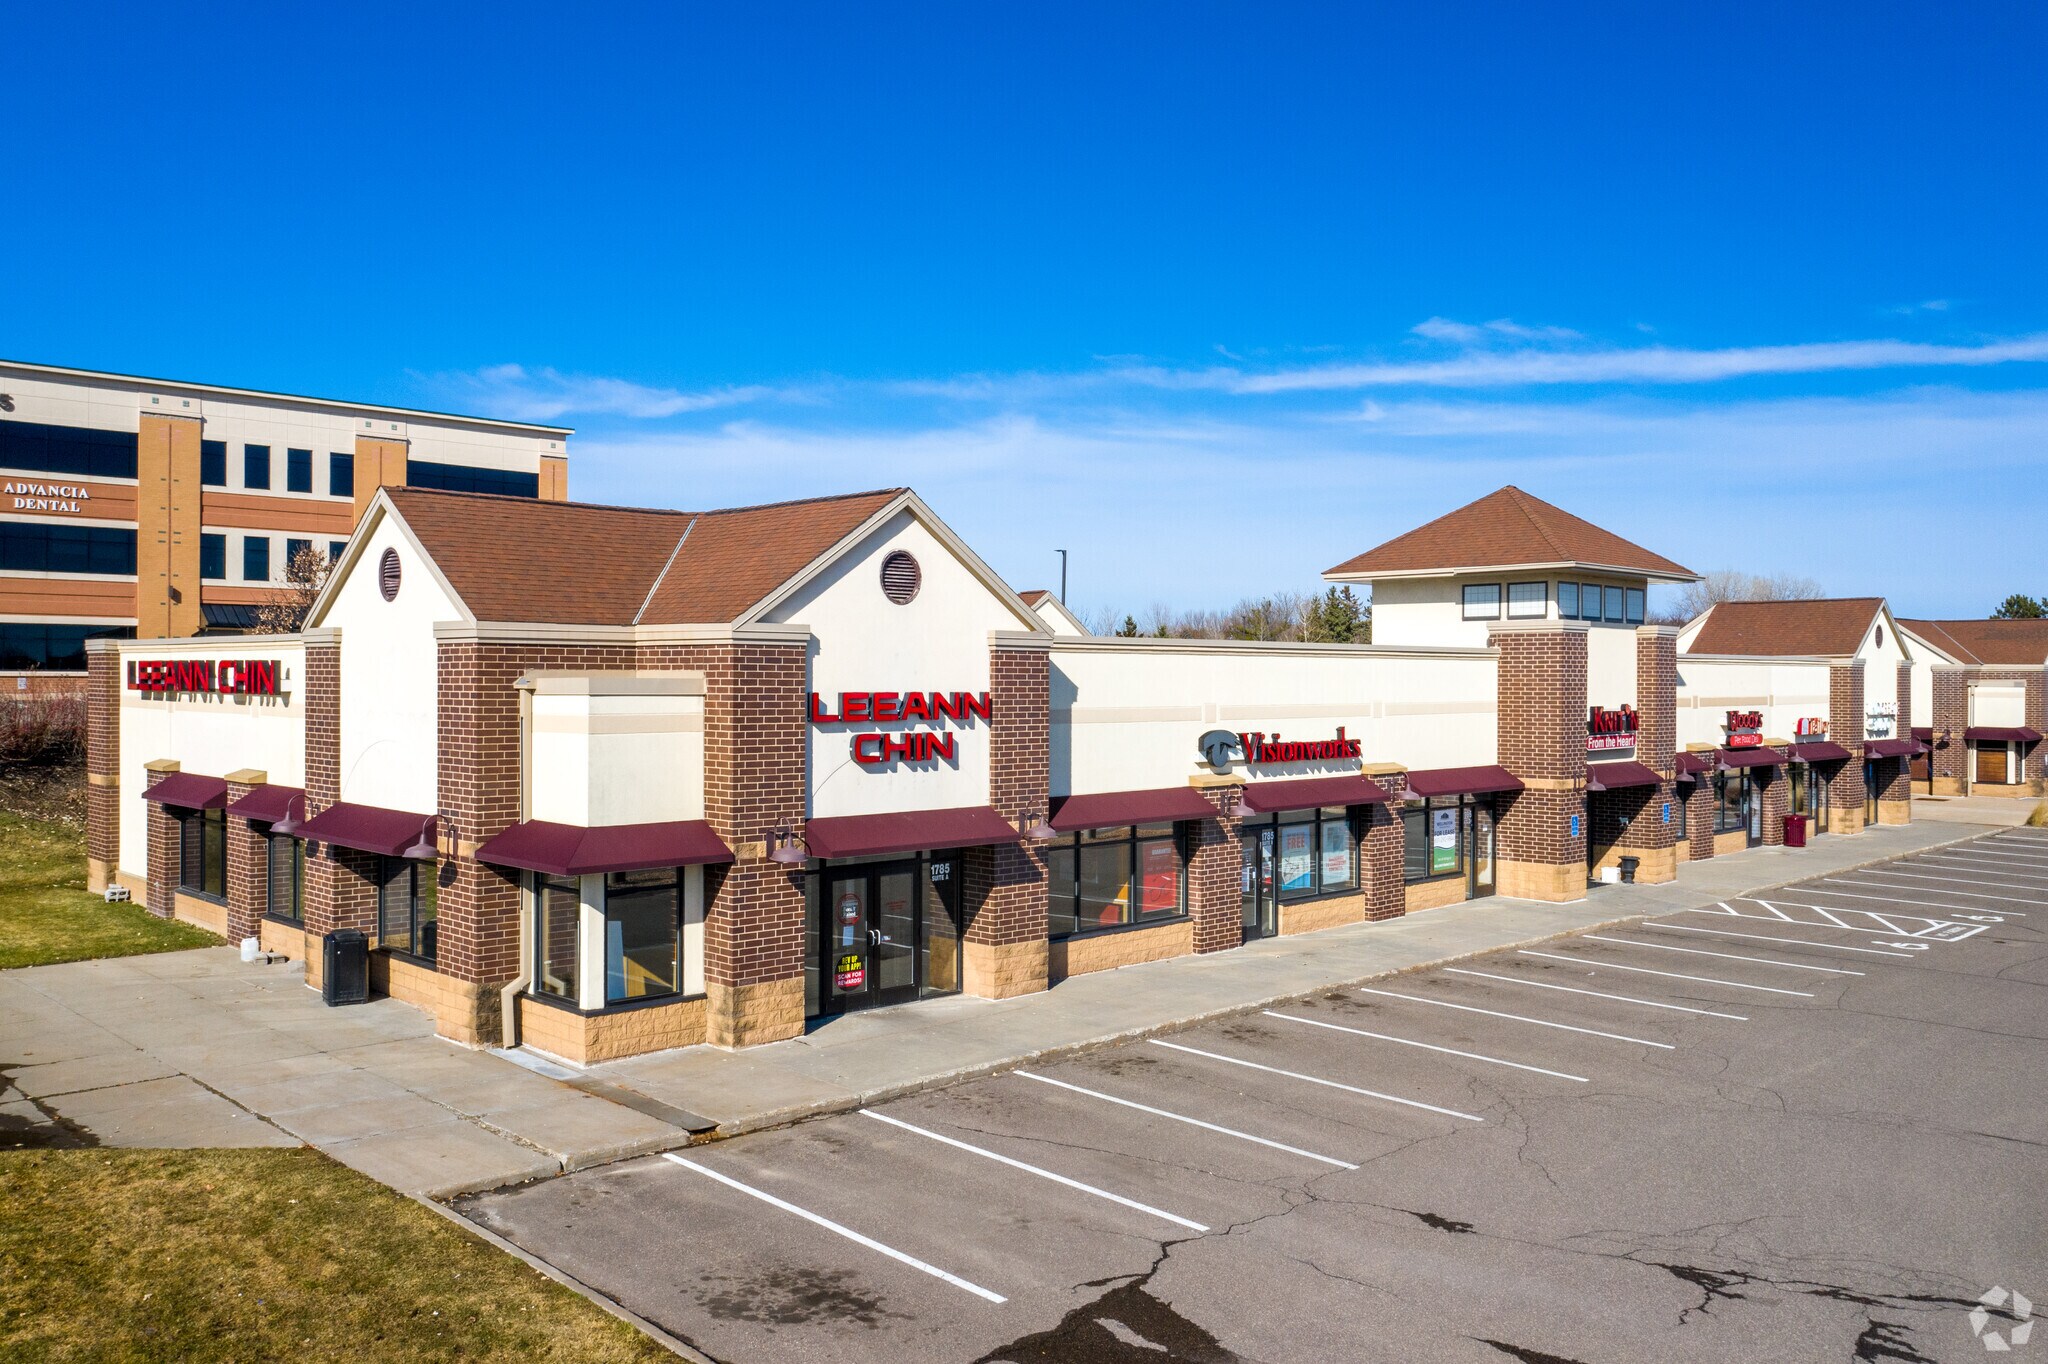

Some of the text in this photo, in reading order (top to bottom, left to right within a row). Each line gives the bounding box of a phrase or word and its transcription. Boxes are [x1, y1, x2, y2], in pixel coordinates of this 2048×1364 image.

[4, 482, 89, 499] ADVANCIA
[14, 498, 81, 513] DENTAL
[127, 660, 275, 695] LEEANN CHIN
[810, 691, 990, 722] LEEANN
[854, 731, 953, 763] CHIN
[1239, 726, 1362, 764] Visionworks
[1588, 734, 1635, 749] From the Heart
[1287, 836, 1305, 849] FREE
[931, 863, 950, 875] 1785
[838, 971, 862, 981] SCAN FOR
